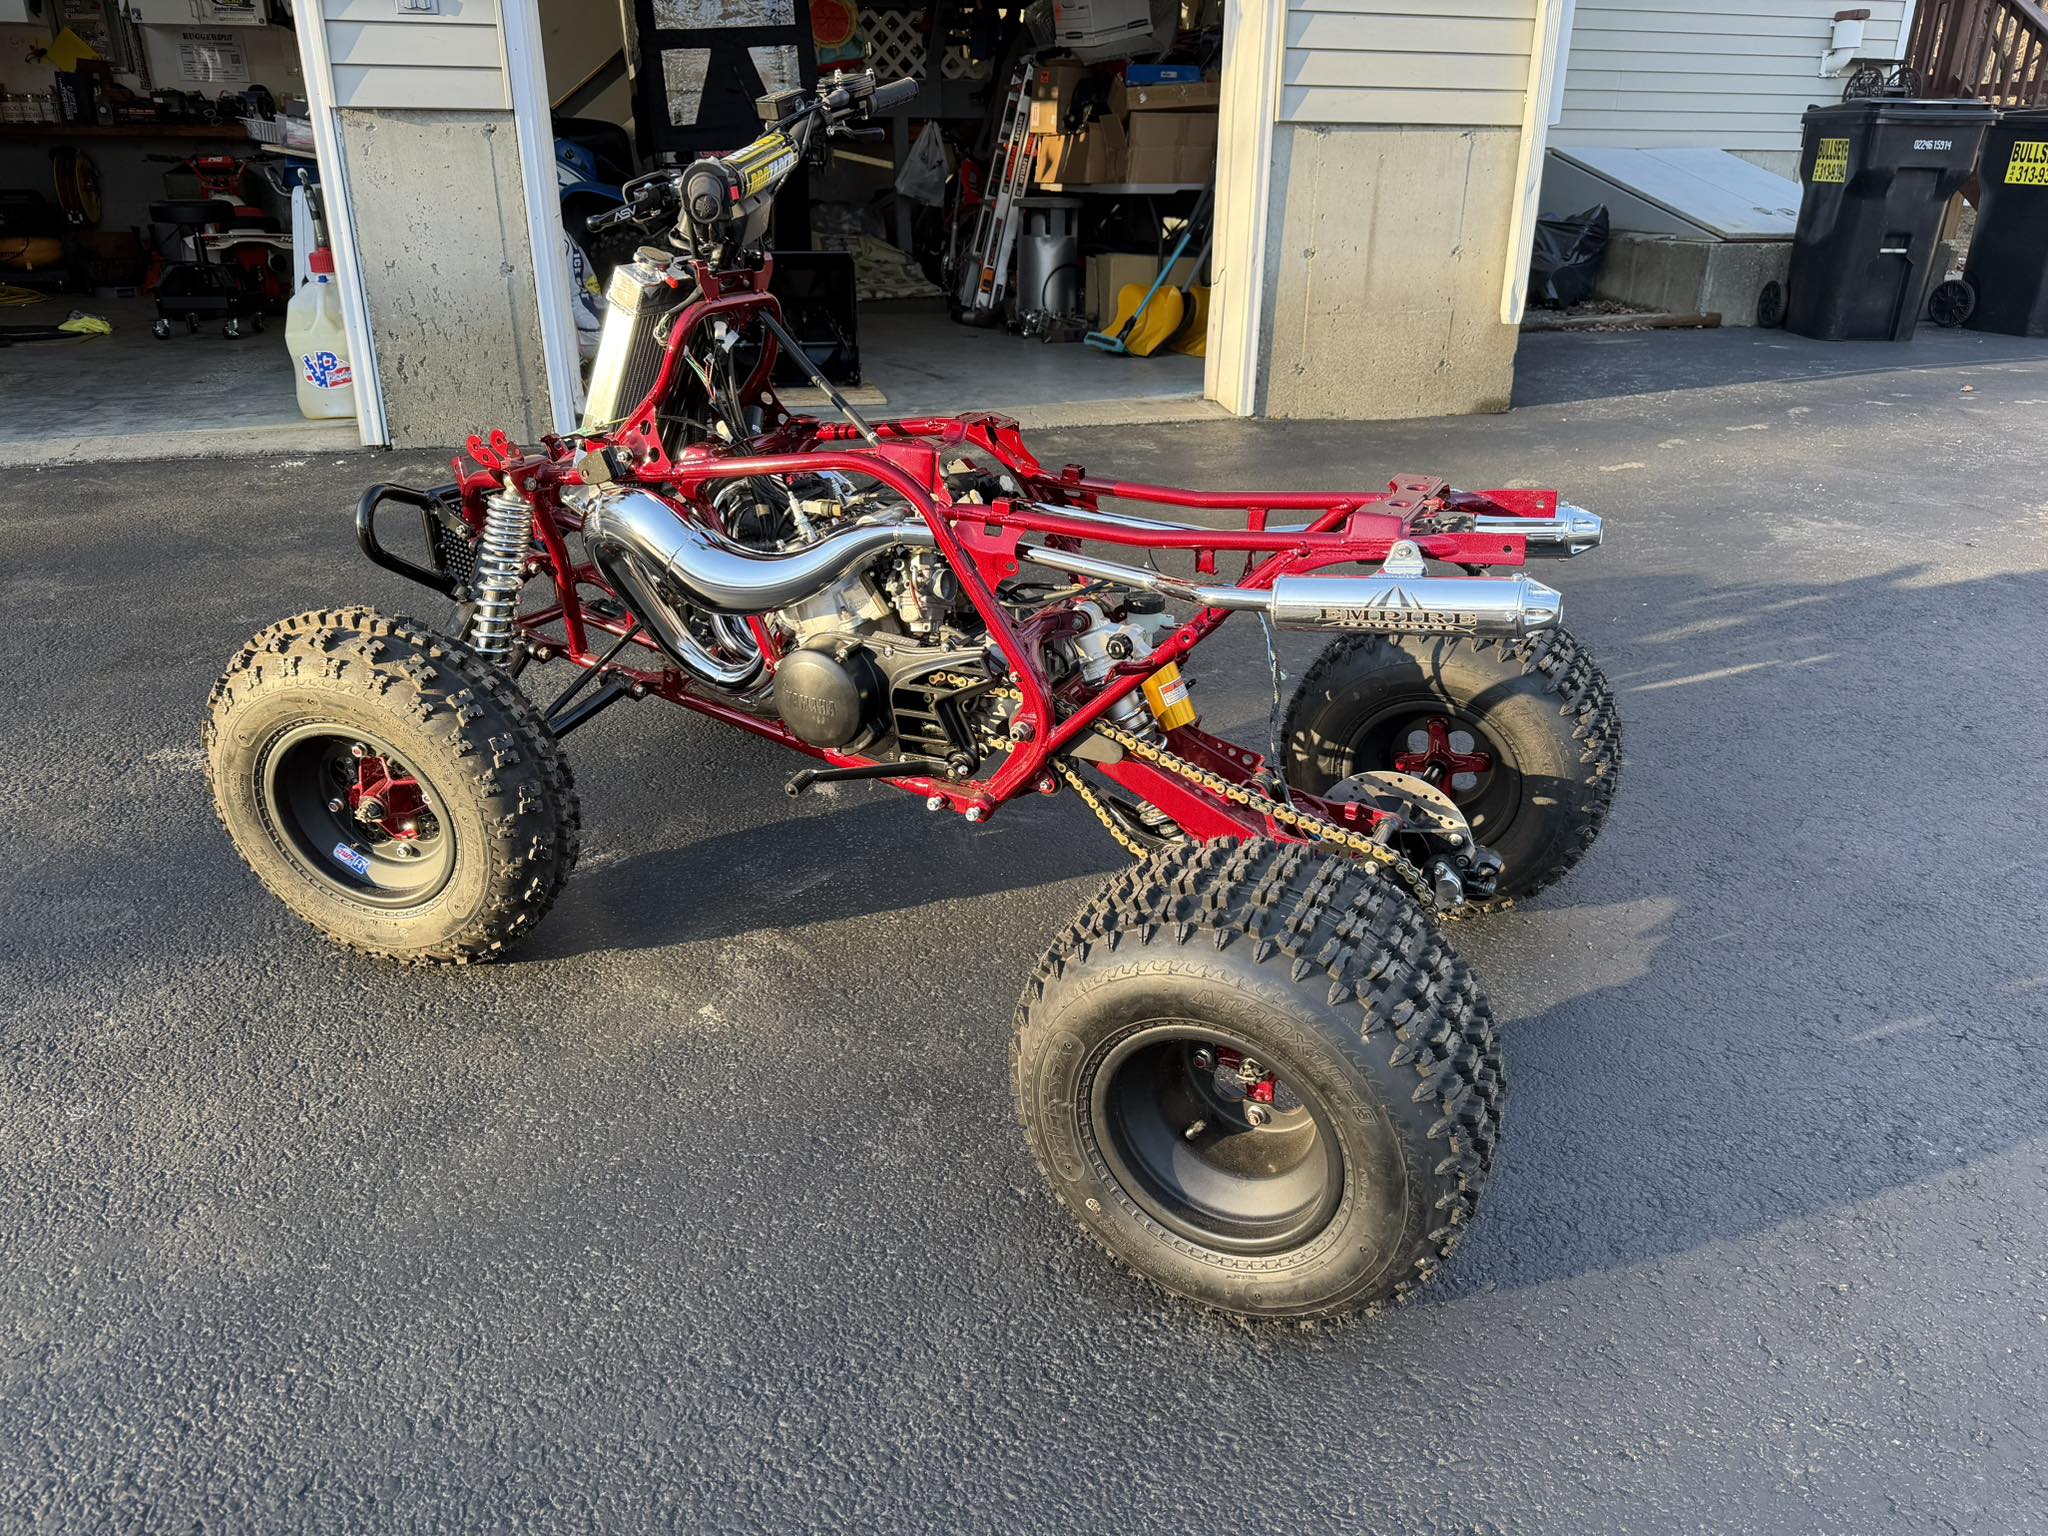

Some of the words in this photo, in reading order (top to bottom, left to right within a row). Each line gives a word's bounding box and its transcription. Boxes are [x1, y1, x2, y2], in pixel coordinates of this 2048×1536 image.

[1817, 140, 1849, 160] BULLSEYE
[2011, 143, 2048, 164] BULLS
[614, 204, 636, 223] ASV
[300, 351, 338, 388] VP
[1317, 608, 1477, 626] EMPIRE
[784, 689, 837, 717] YAMAHA
